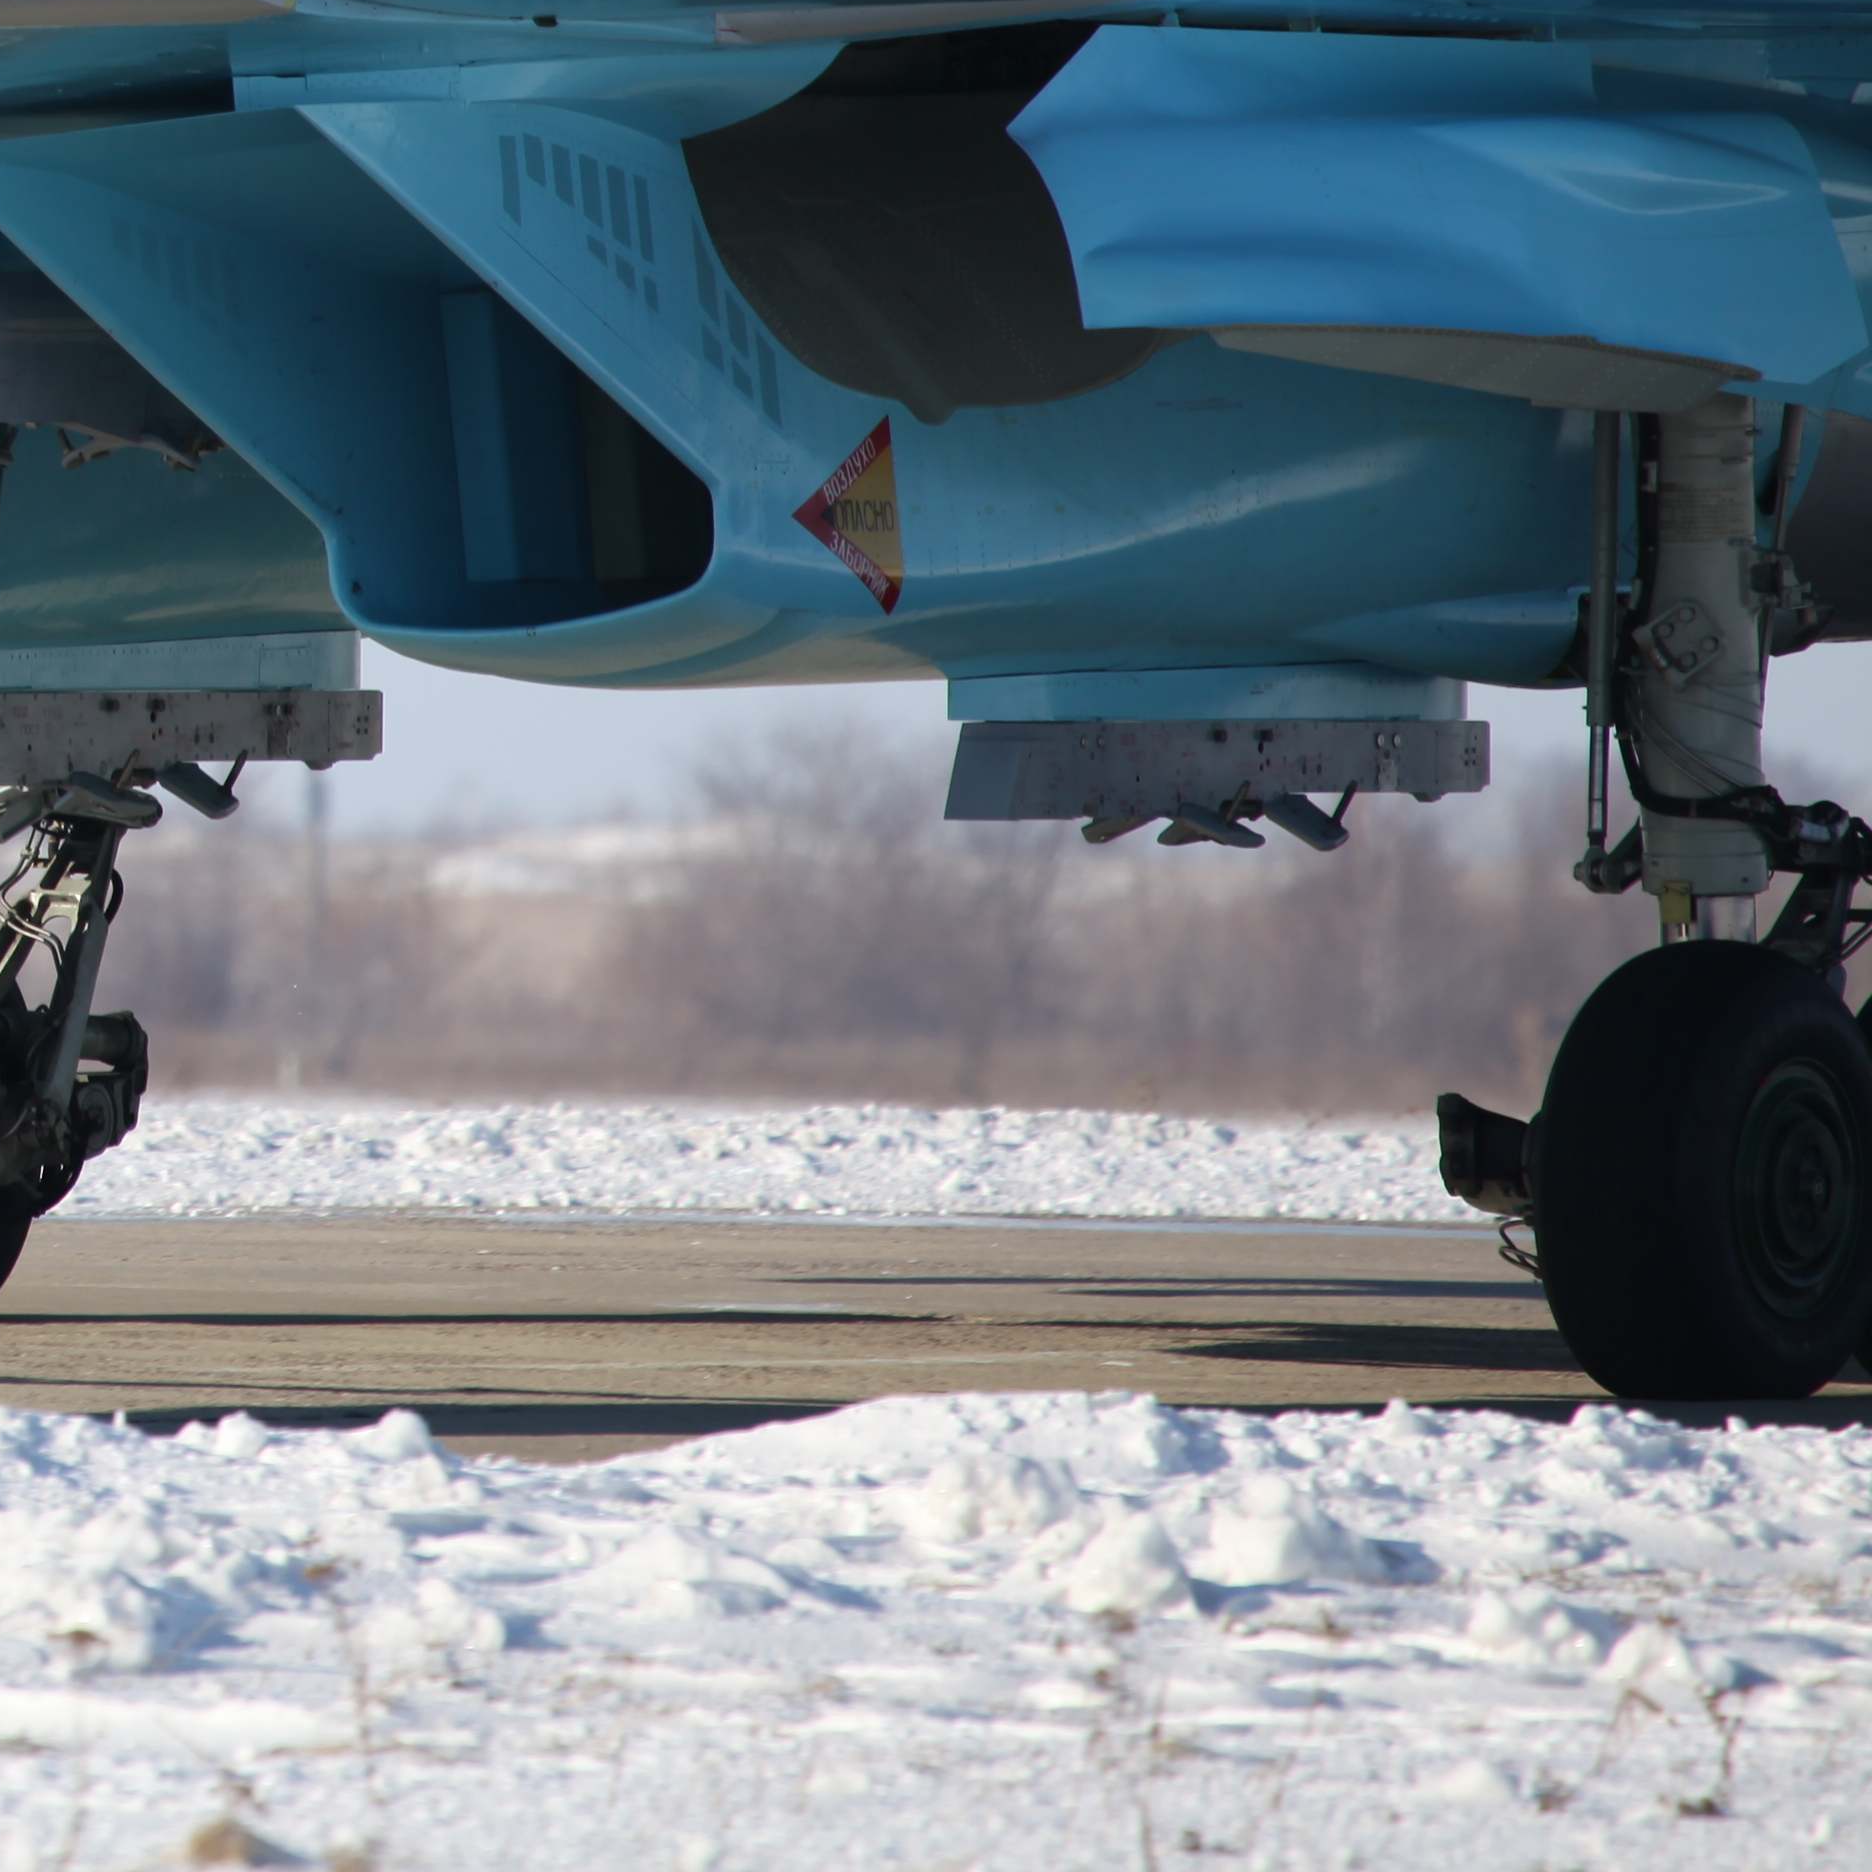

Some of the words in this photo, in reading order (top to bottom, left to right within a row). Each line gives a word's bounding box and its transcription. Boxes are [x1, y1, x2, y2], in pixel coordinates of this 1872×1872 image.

[823, 437, 876, 506] ВОЗДУХО
[834, 499, 895, 532] ОПАСНО
[830, 530, 891, 603] ЗАБОРНИК
